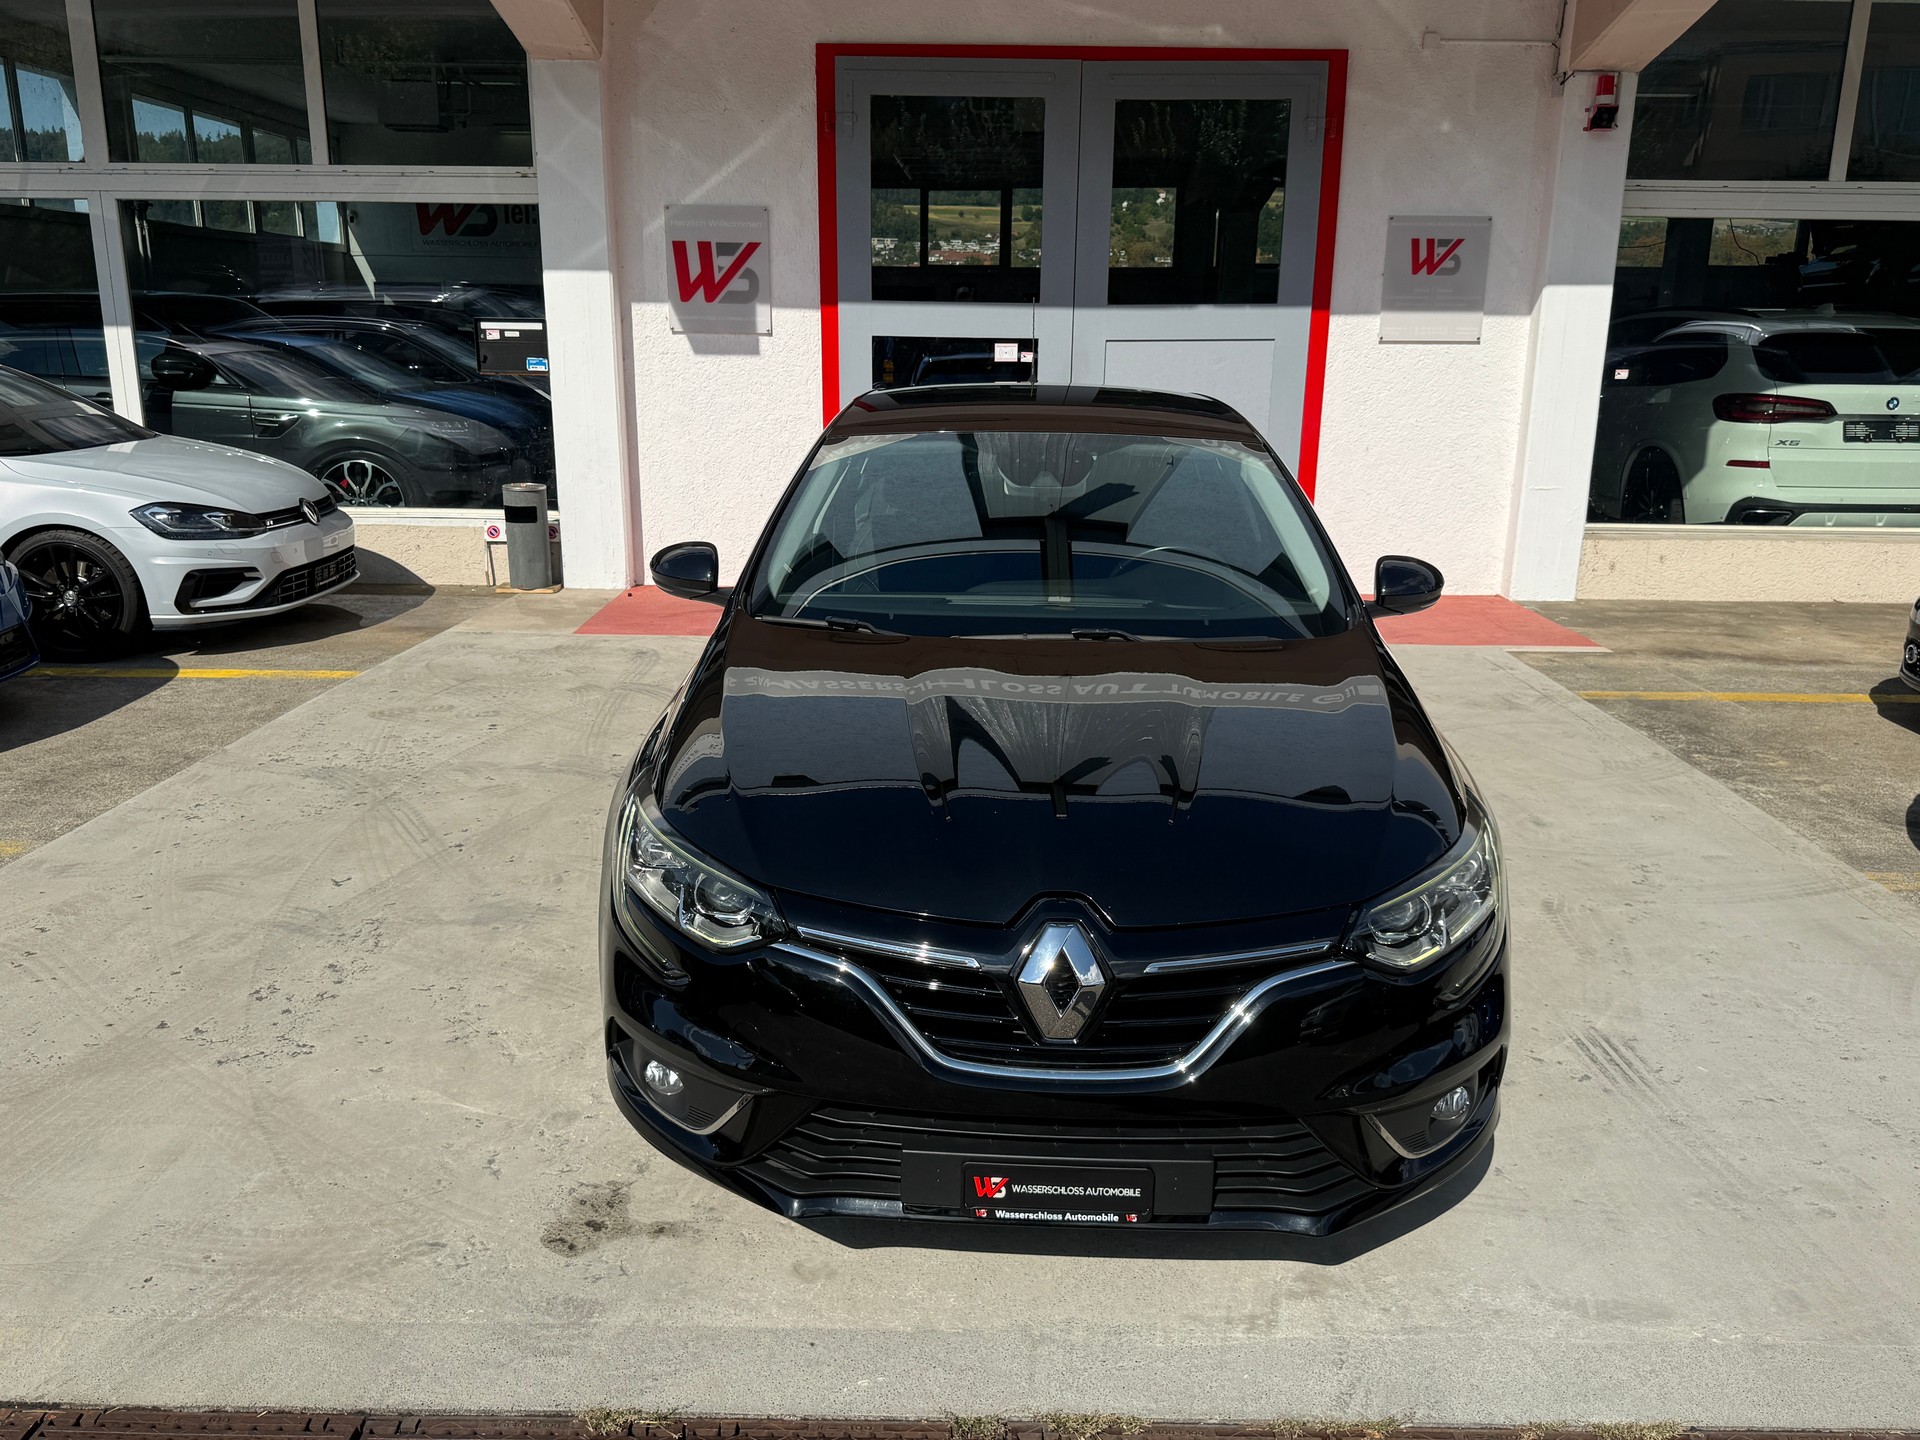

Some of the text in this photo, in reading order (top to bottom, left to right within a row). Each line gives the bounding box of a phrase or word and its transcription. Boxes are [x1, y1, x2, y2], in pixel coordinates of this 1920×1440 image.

[1774, 439, 1801, 447] X5
[1011, 1184, 1141, 1197] WASSERSCHLOSS AUTOMOBILE
[994, 1209, 1063, 1221] Wasserschloss
[1065, 1212, 1119, 1222] Automobile
